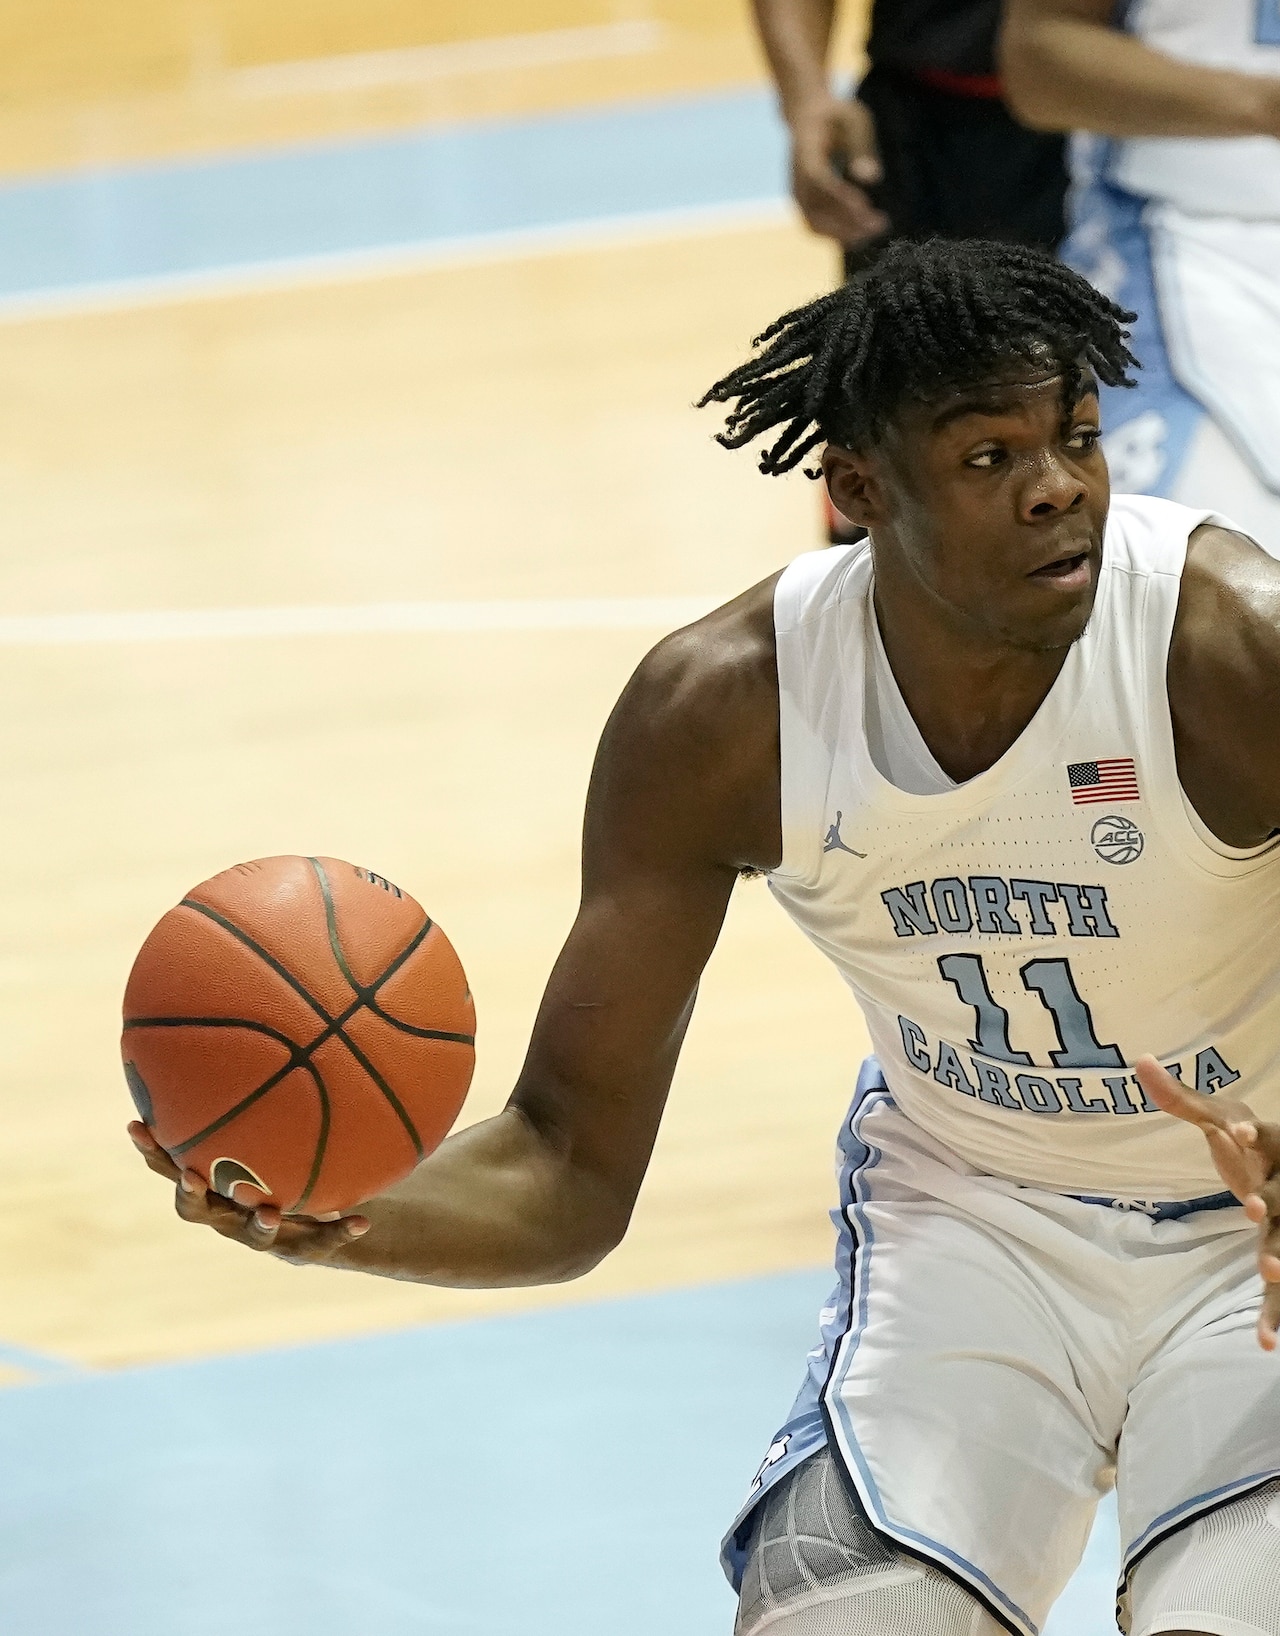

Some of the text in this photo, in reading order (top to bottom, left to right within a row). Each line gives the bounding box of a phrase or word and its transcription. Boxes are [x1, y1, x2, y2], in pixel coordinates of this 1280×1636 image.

[1097, 829, 1140, 845] ACC
[881, 875, 1120, 938] NORTH
[937, 952, 1127, 1069] 11
